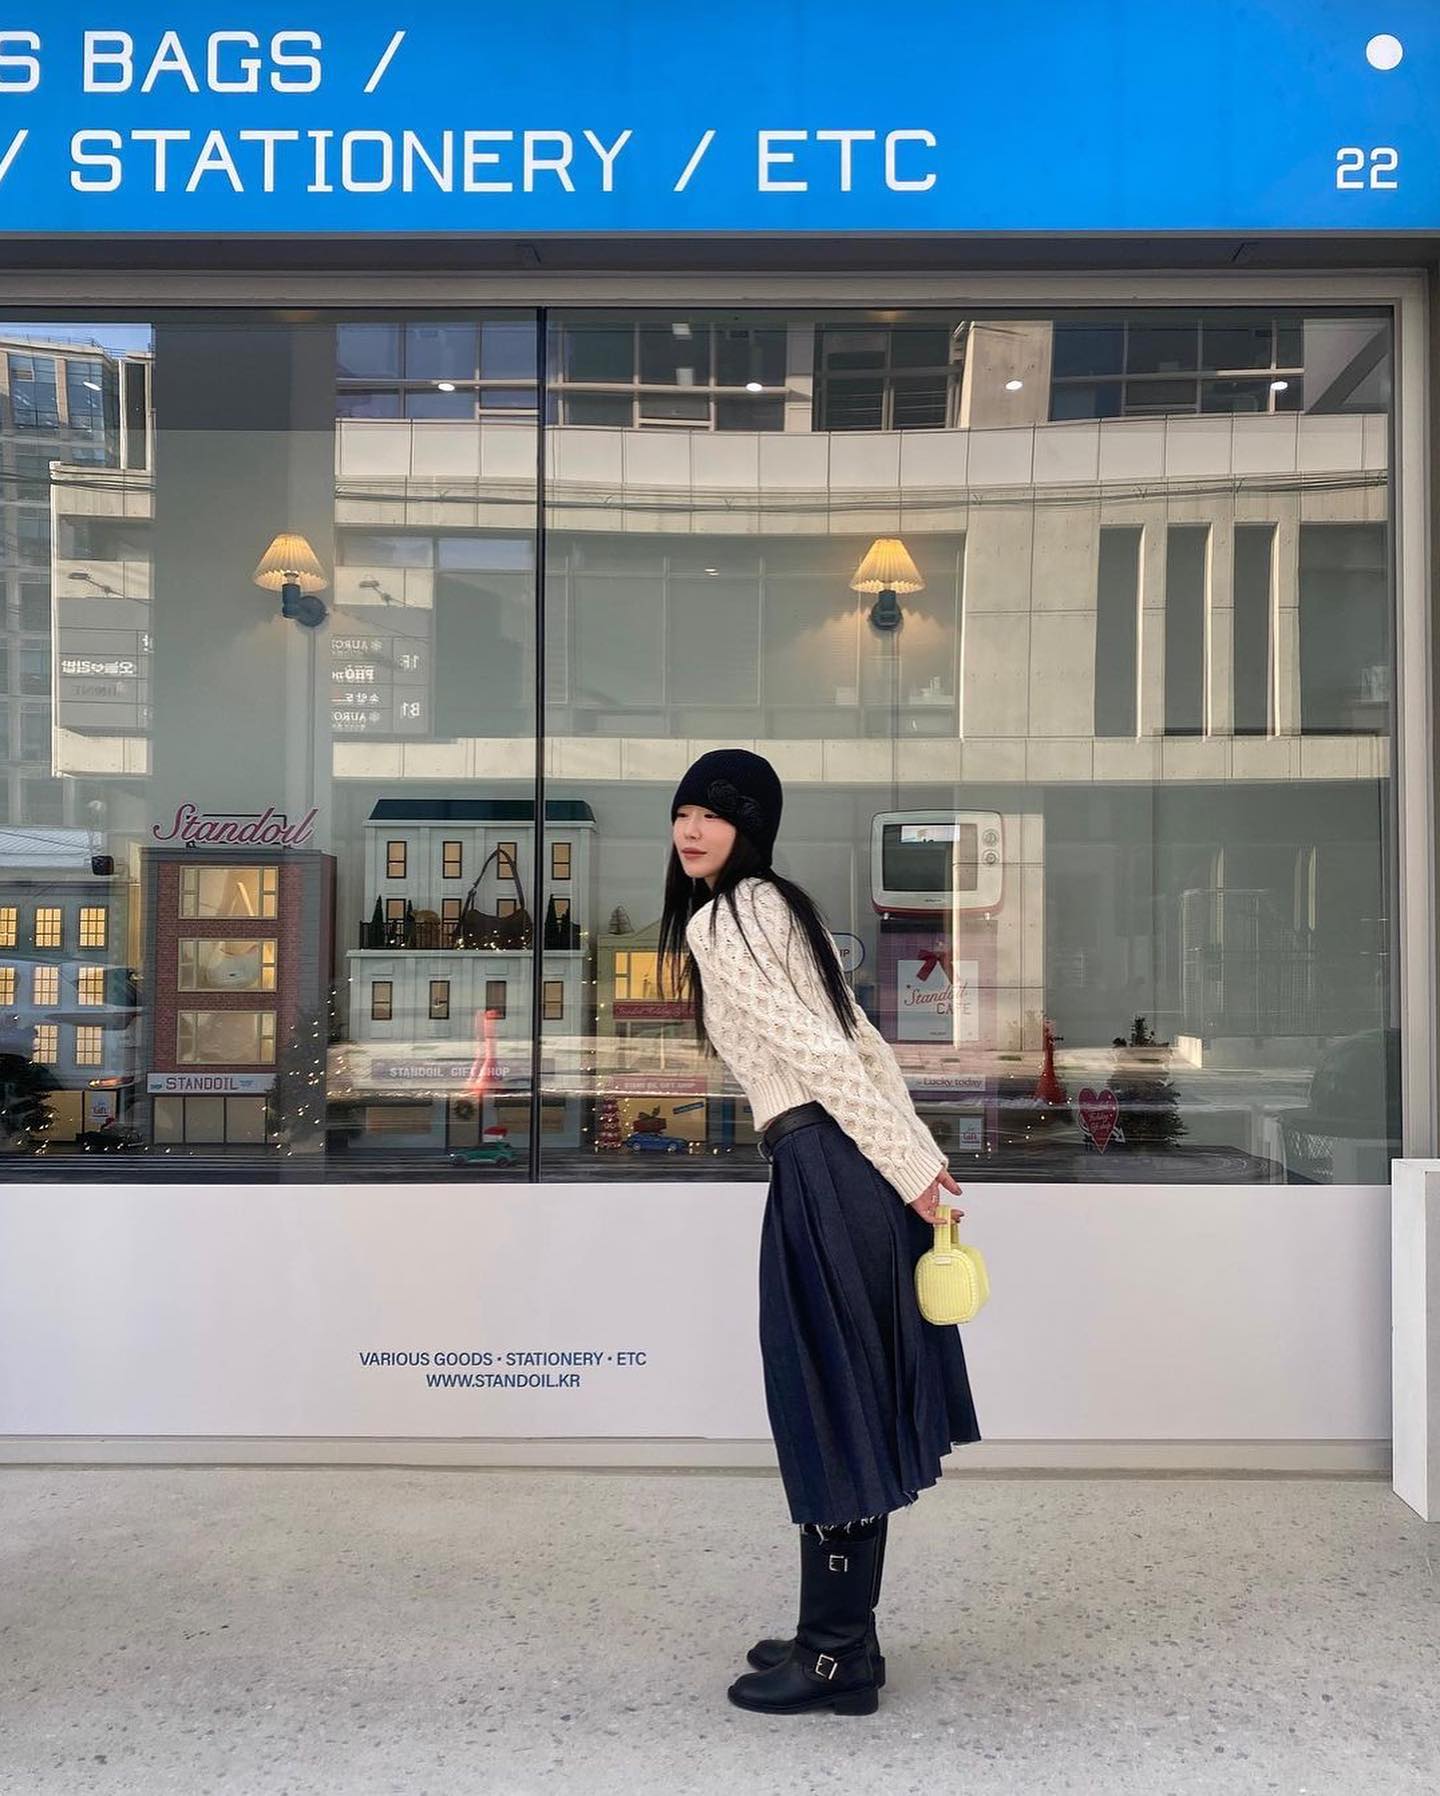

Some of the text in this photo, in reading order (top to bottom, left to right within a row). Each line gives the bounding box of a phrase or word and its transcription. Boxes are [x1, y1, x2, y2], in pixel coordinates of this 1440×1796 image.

[84, 31, 322, 93] BAGS
[71, 129, 632, 192] STATIONERY
[758, 129, 937, 192] ETC
[1336, 147, 1398, 189] 22
[165, 1077, 239, 1090] STANDOIL
[359, 1352, 647, 1366] VARIOUS GOODS STATIONERY ETC
[426, 1374, 581, 1388] WWW.STANDOIL.KR
